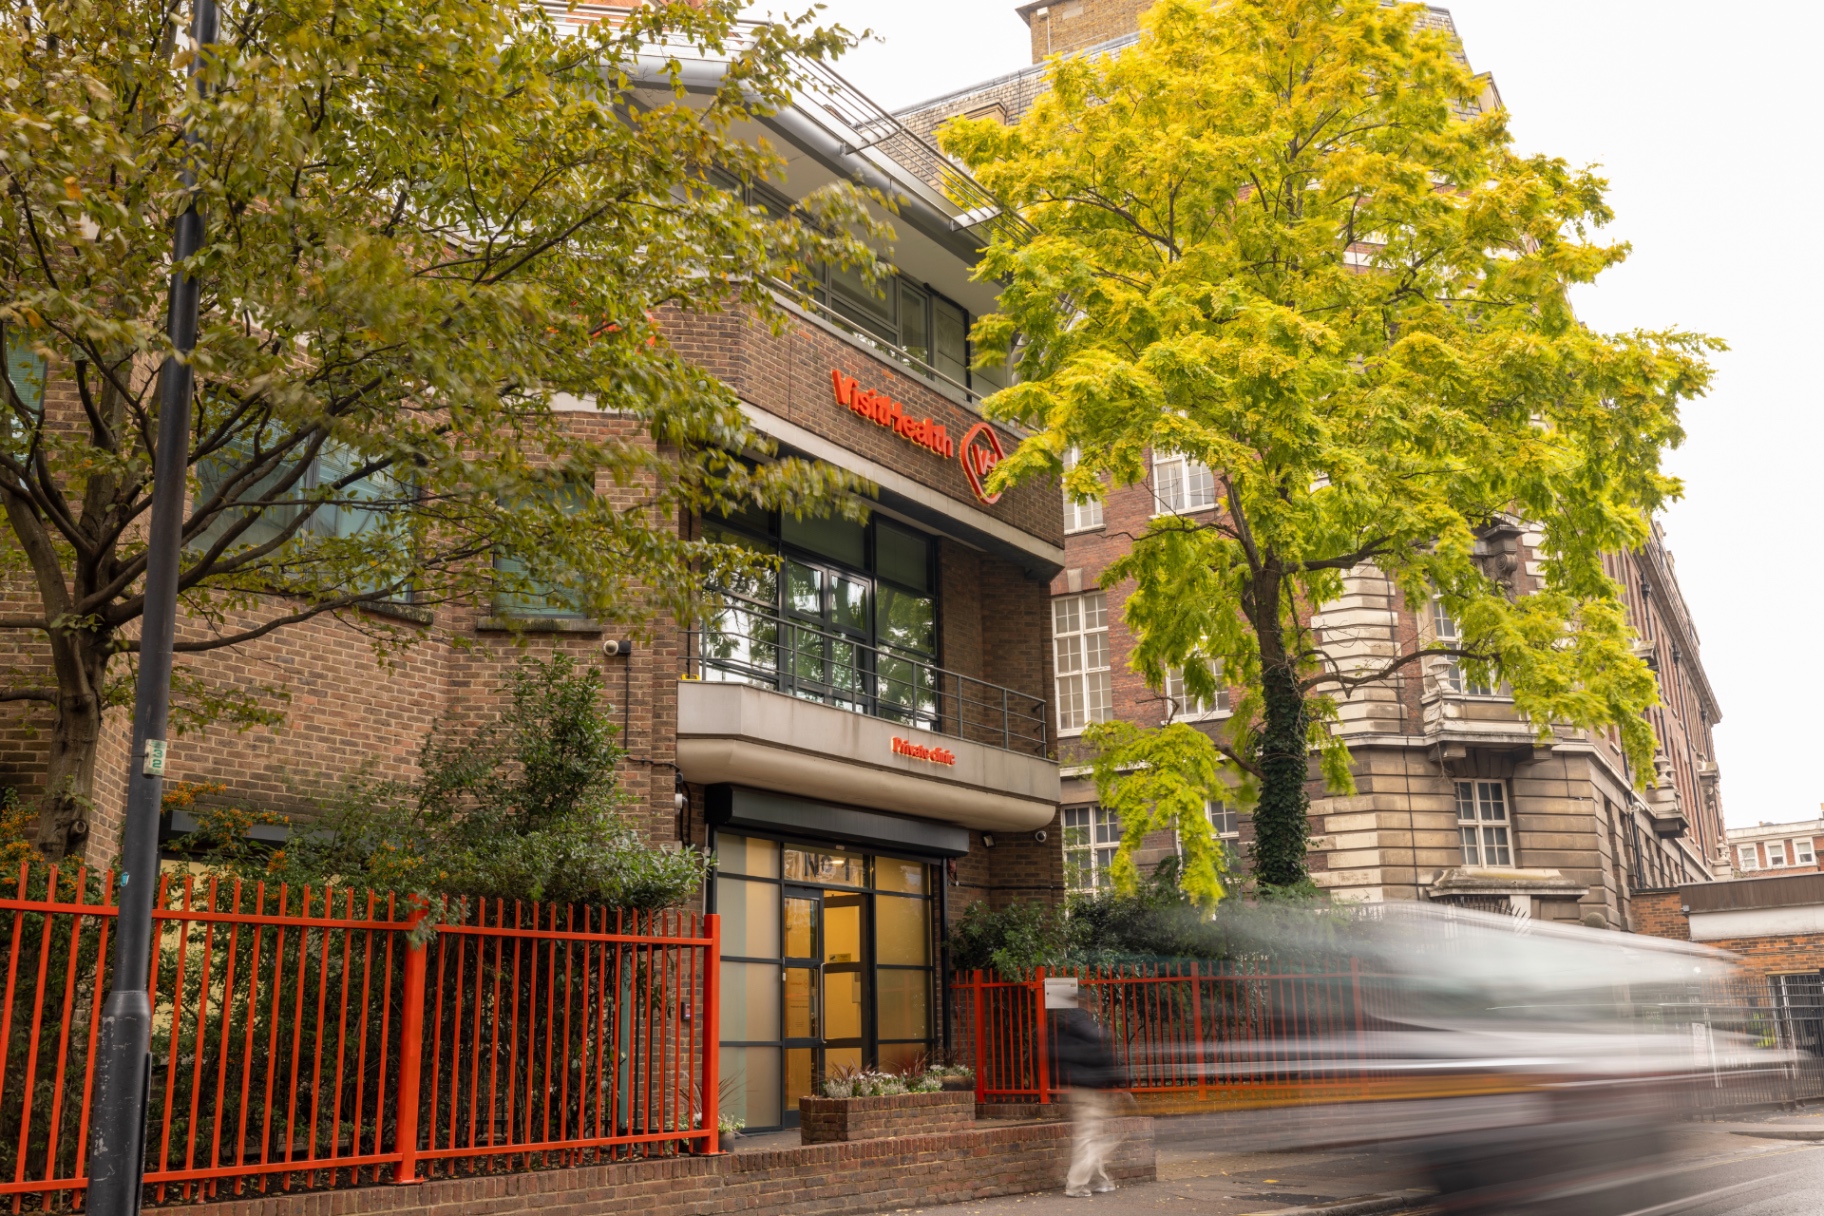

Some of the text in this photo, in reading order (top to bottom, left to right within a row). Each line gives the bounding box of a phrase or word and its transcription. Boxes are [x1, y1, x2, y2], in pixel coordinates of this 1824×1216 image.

[832, 369, 954, 458] VisitHealth
[892, 736, 956, 766] Private clinic
